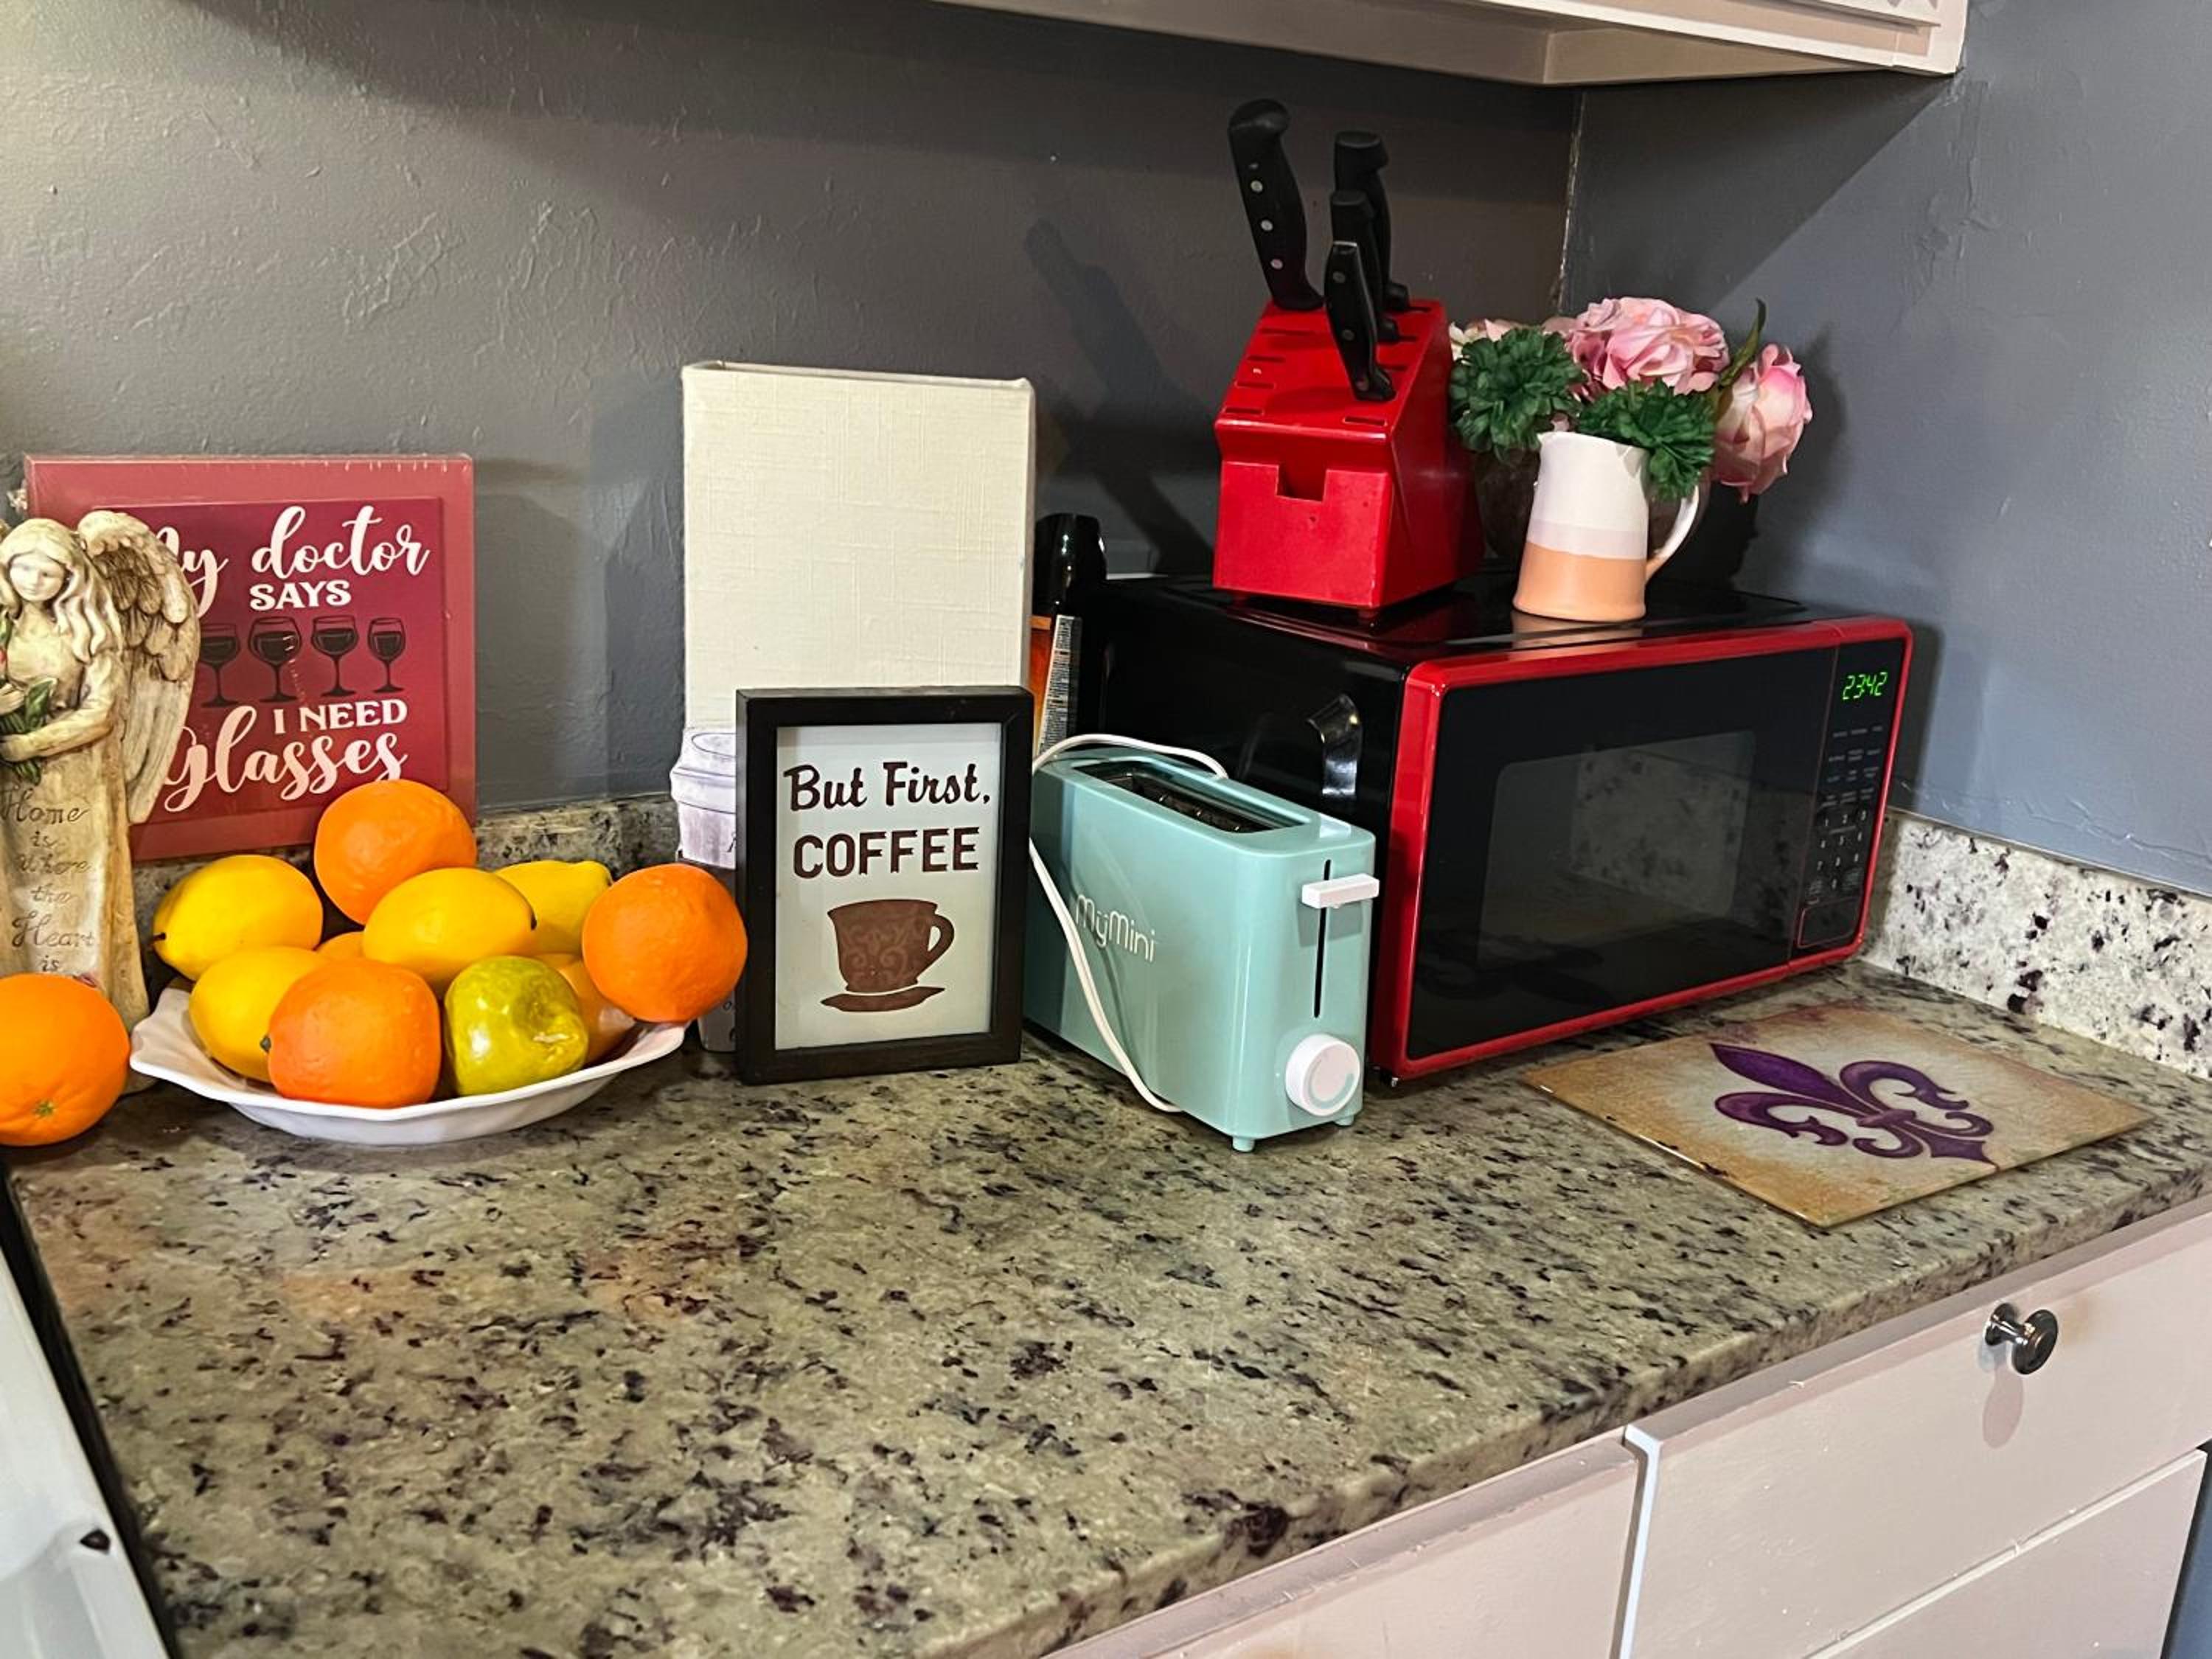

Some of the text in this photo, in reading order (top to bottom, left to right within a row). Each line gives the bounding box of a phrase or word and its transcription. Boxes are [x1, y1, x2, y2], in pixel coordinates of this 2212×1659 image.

[251, 505, 431, 580] doctor
[249, 580, 352, 611] SAYS
[1842, 672, 1888, 700] 2342
[273, 698, 408, 734] I NEED
[164, 706, 409, 812] glasses
[0, 783, 90, 824] Home
[783, 761, 991, 811] But First,
[30, 830, 58, 848] is
[793, 826, 980, 879] COFFEE
[30, 883, 72, 903] the
[12, 910, 94, 947] Heart
[1075, 894, 1155, 963] MyMini
[40, 955, 60, 972] is
